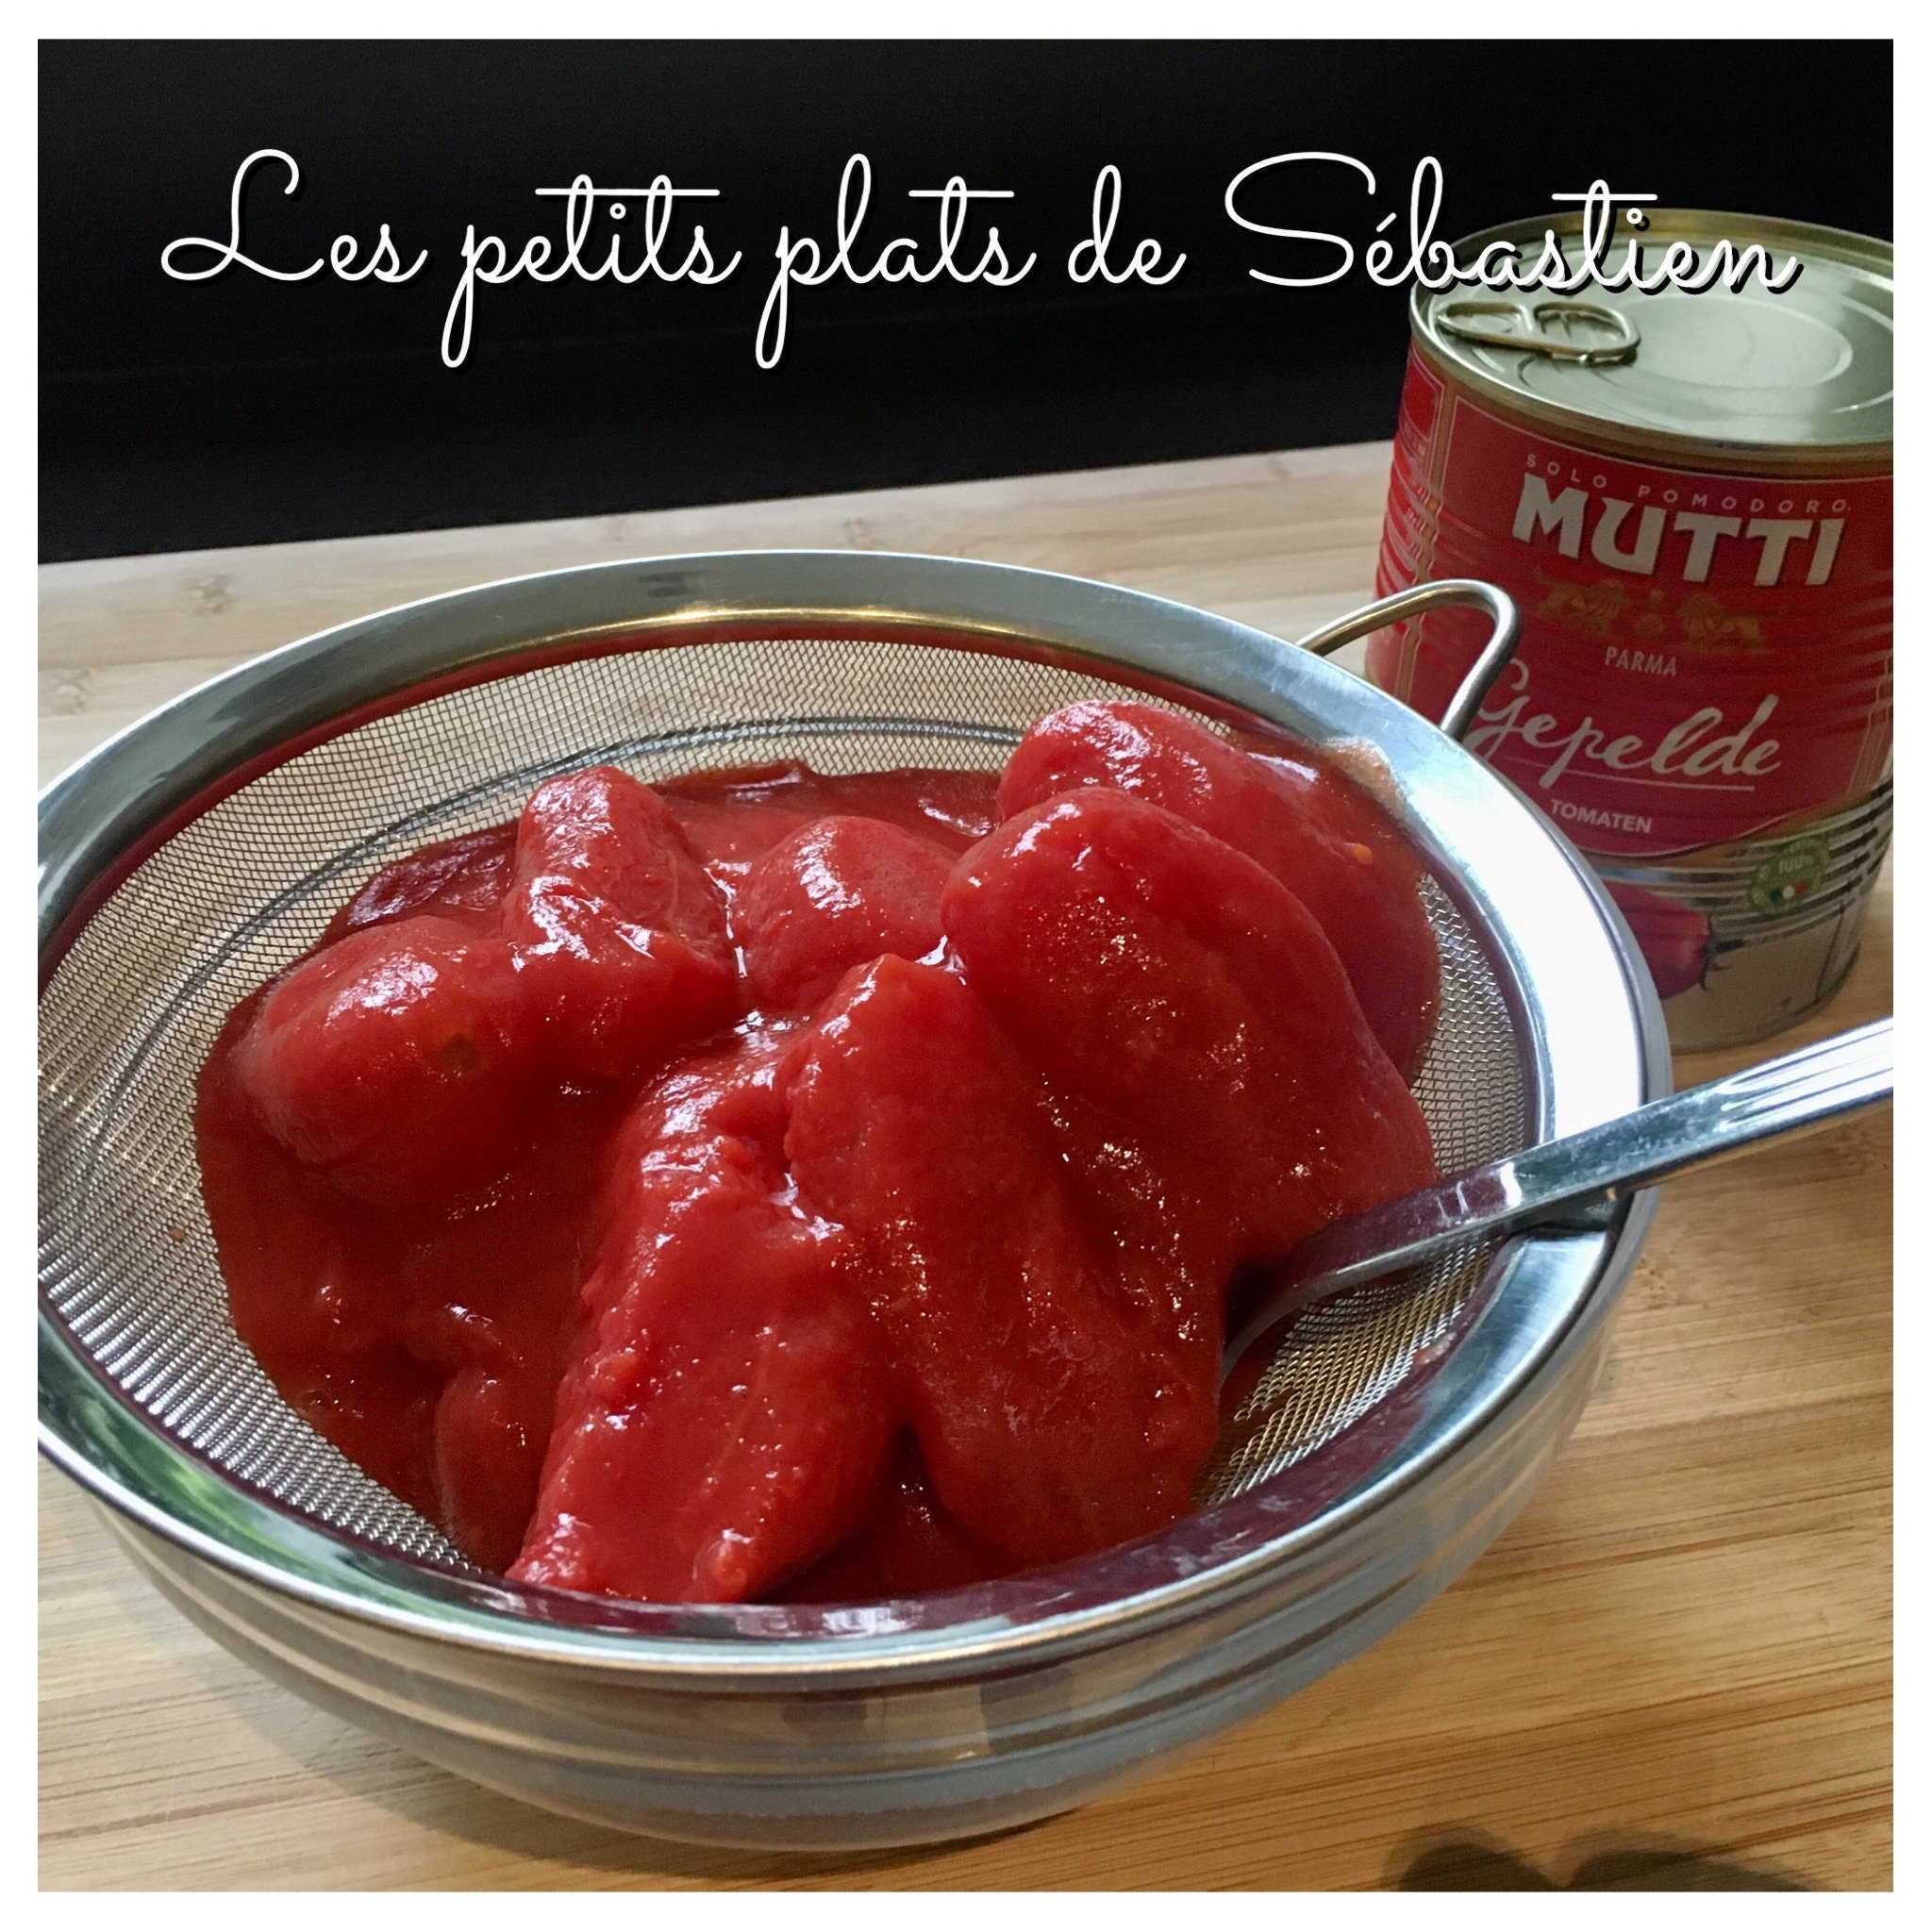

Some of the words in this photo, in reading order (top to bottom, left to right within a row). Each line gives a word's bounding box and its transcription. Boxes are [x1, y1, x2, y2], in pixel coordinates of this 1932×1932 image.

[1525, 453, 1607, 489] SOLO
[1511, 472, 1846, 588] MUTTI
[1604, 645, 1677, 677] PARMA
[1462, 656, 1781, 789] Gepelde
[1550, 798, 1653, 834] TOMATEN
